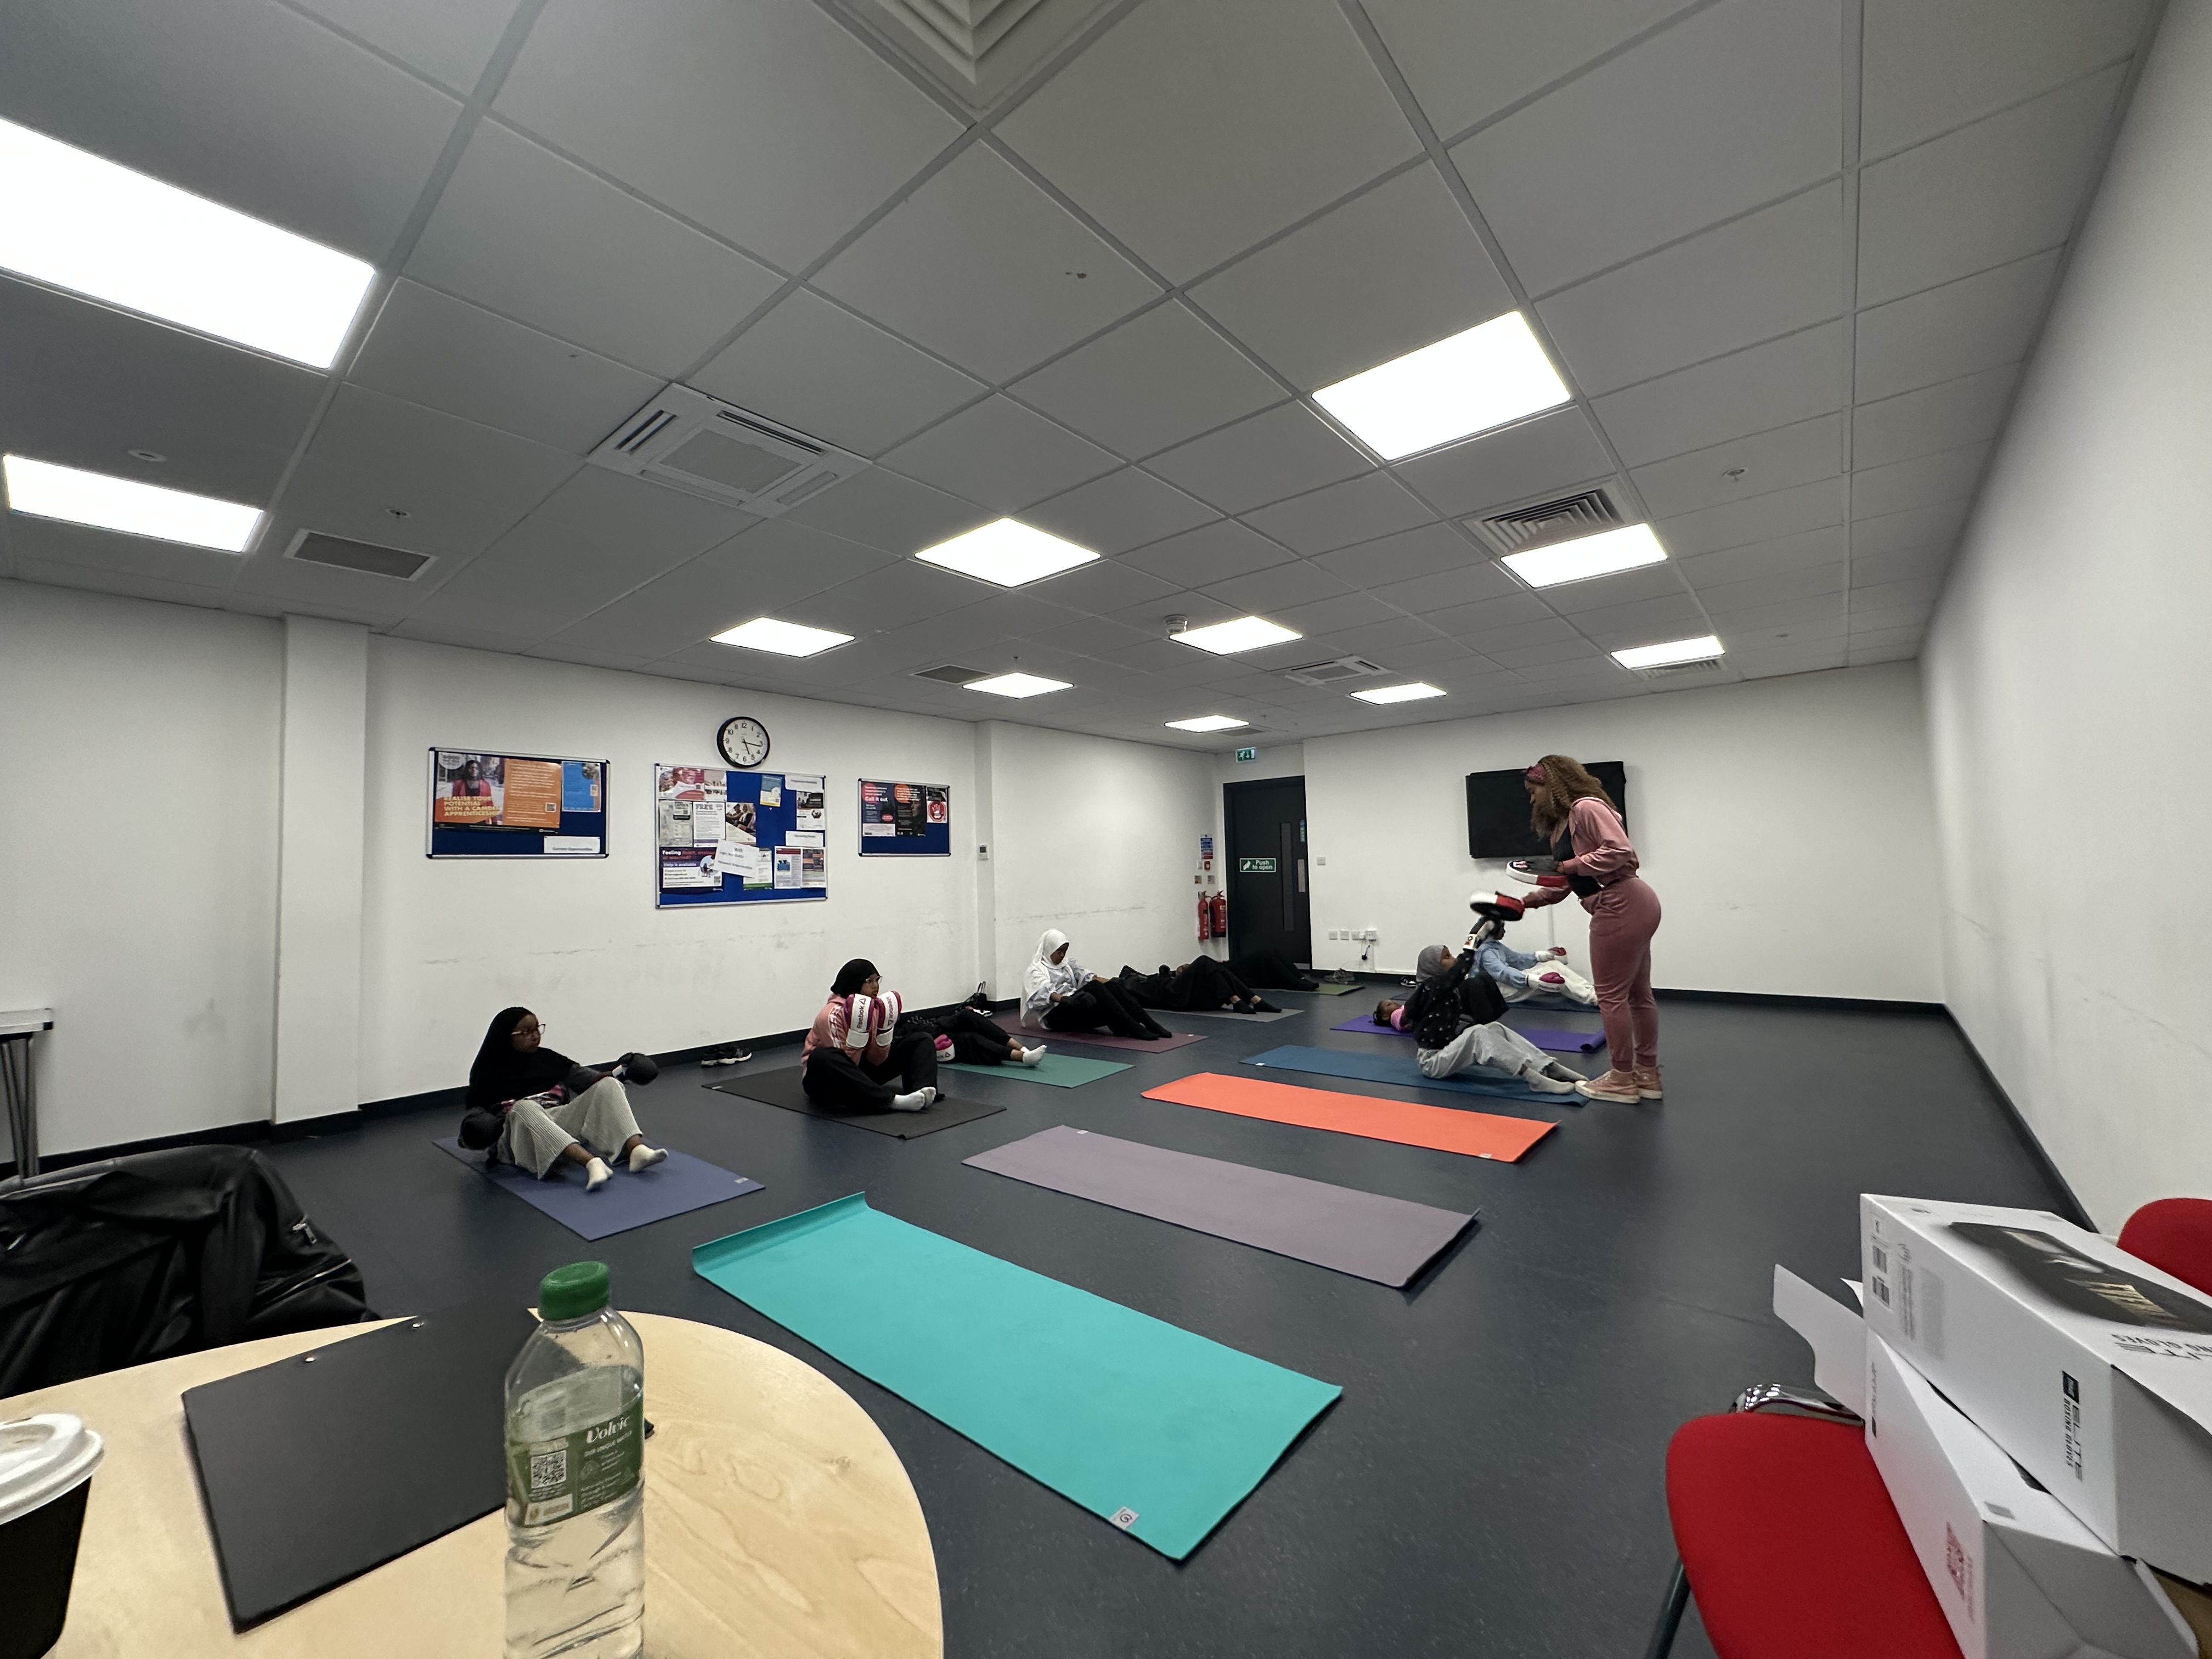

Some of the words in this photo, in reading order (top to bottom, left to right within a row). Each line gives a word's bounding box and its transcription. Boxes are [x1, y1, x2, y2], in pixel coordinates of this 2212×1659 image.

[586, 1417, 630, 1444] Volvic
[2064, 1398, 2072, 1432] BOXING
[2065, 1433, 2074, 1468] GLOVES
[2072, 1404, 2083, 1482] ELITE
